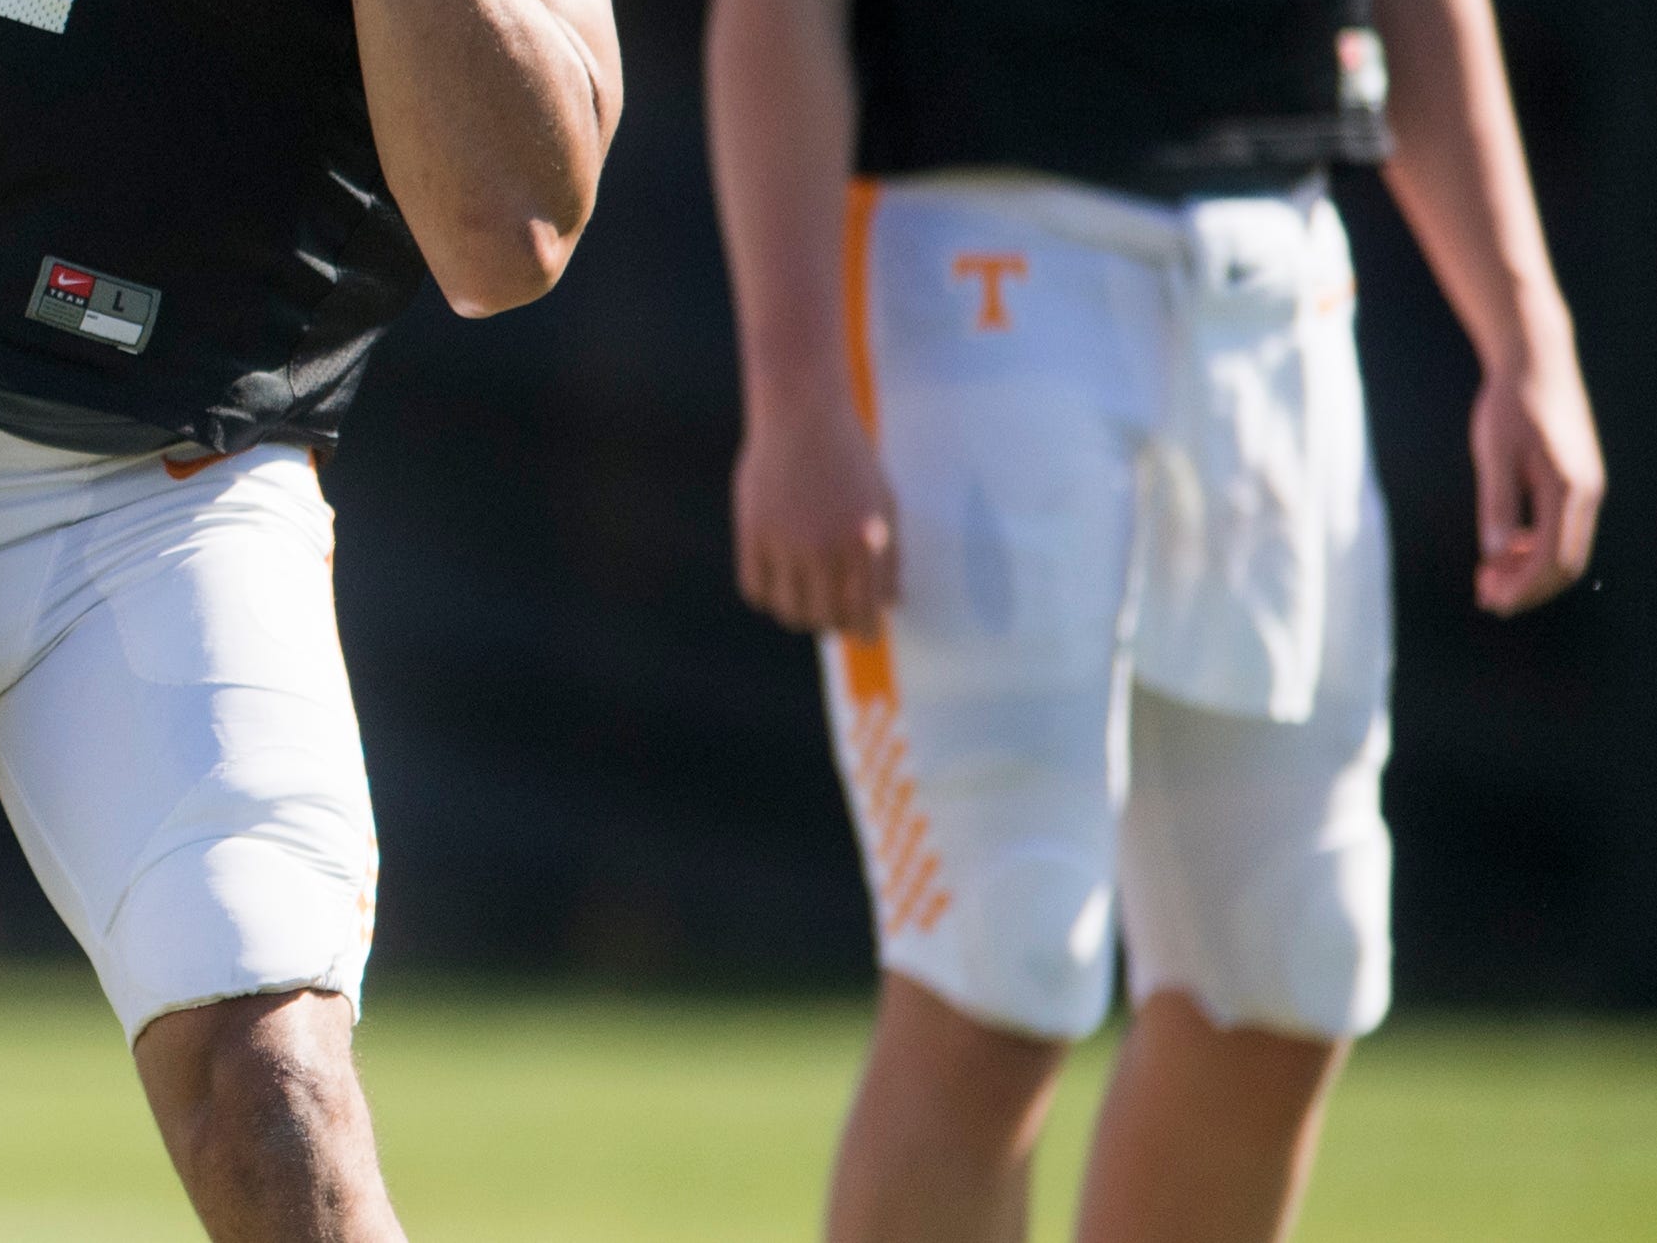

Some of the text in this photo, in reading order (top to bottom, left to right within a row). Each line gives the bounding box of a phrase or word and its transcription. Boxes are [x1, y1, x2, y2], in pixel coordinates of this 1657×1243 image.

[50, 288, 84, 305] TEAM
[112, 290, 125, 312] L
[952, 249, 1030, 333] T
